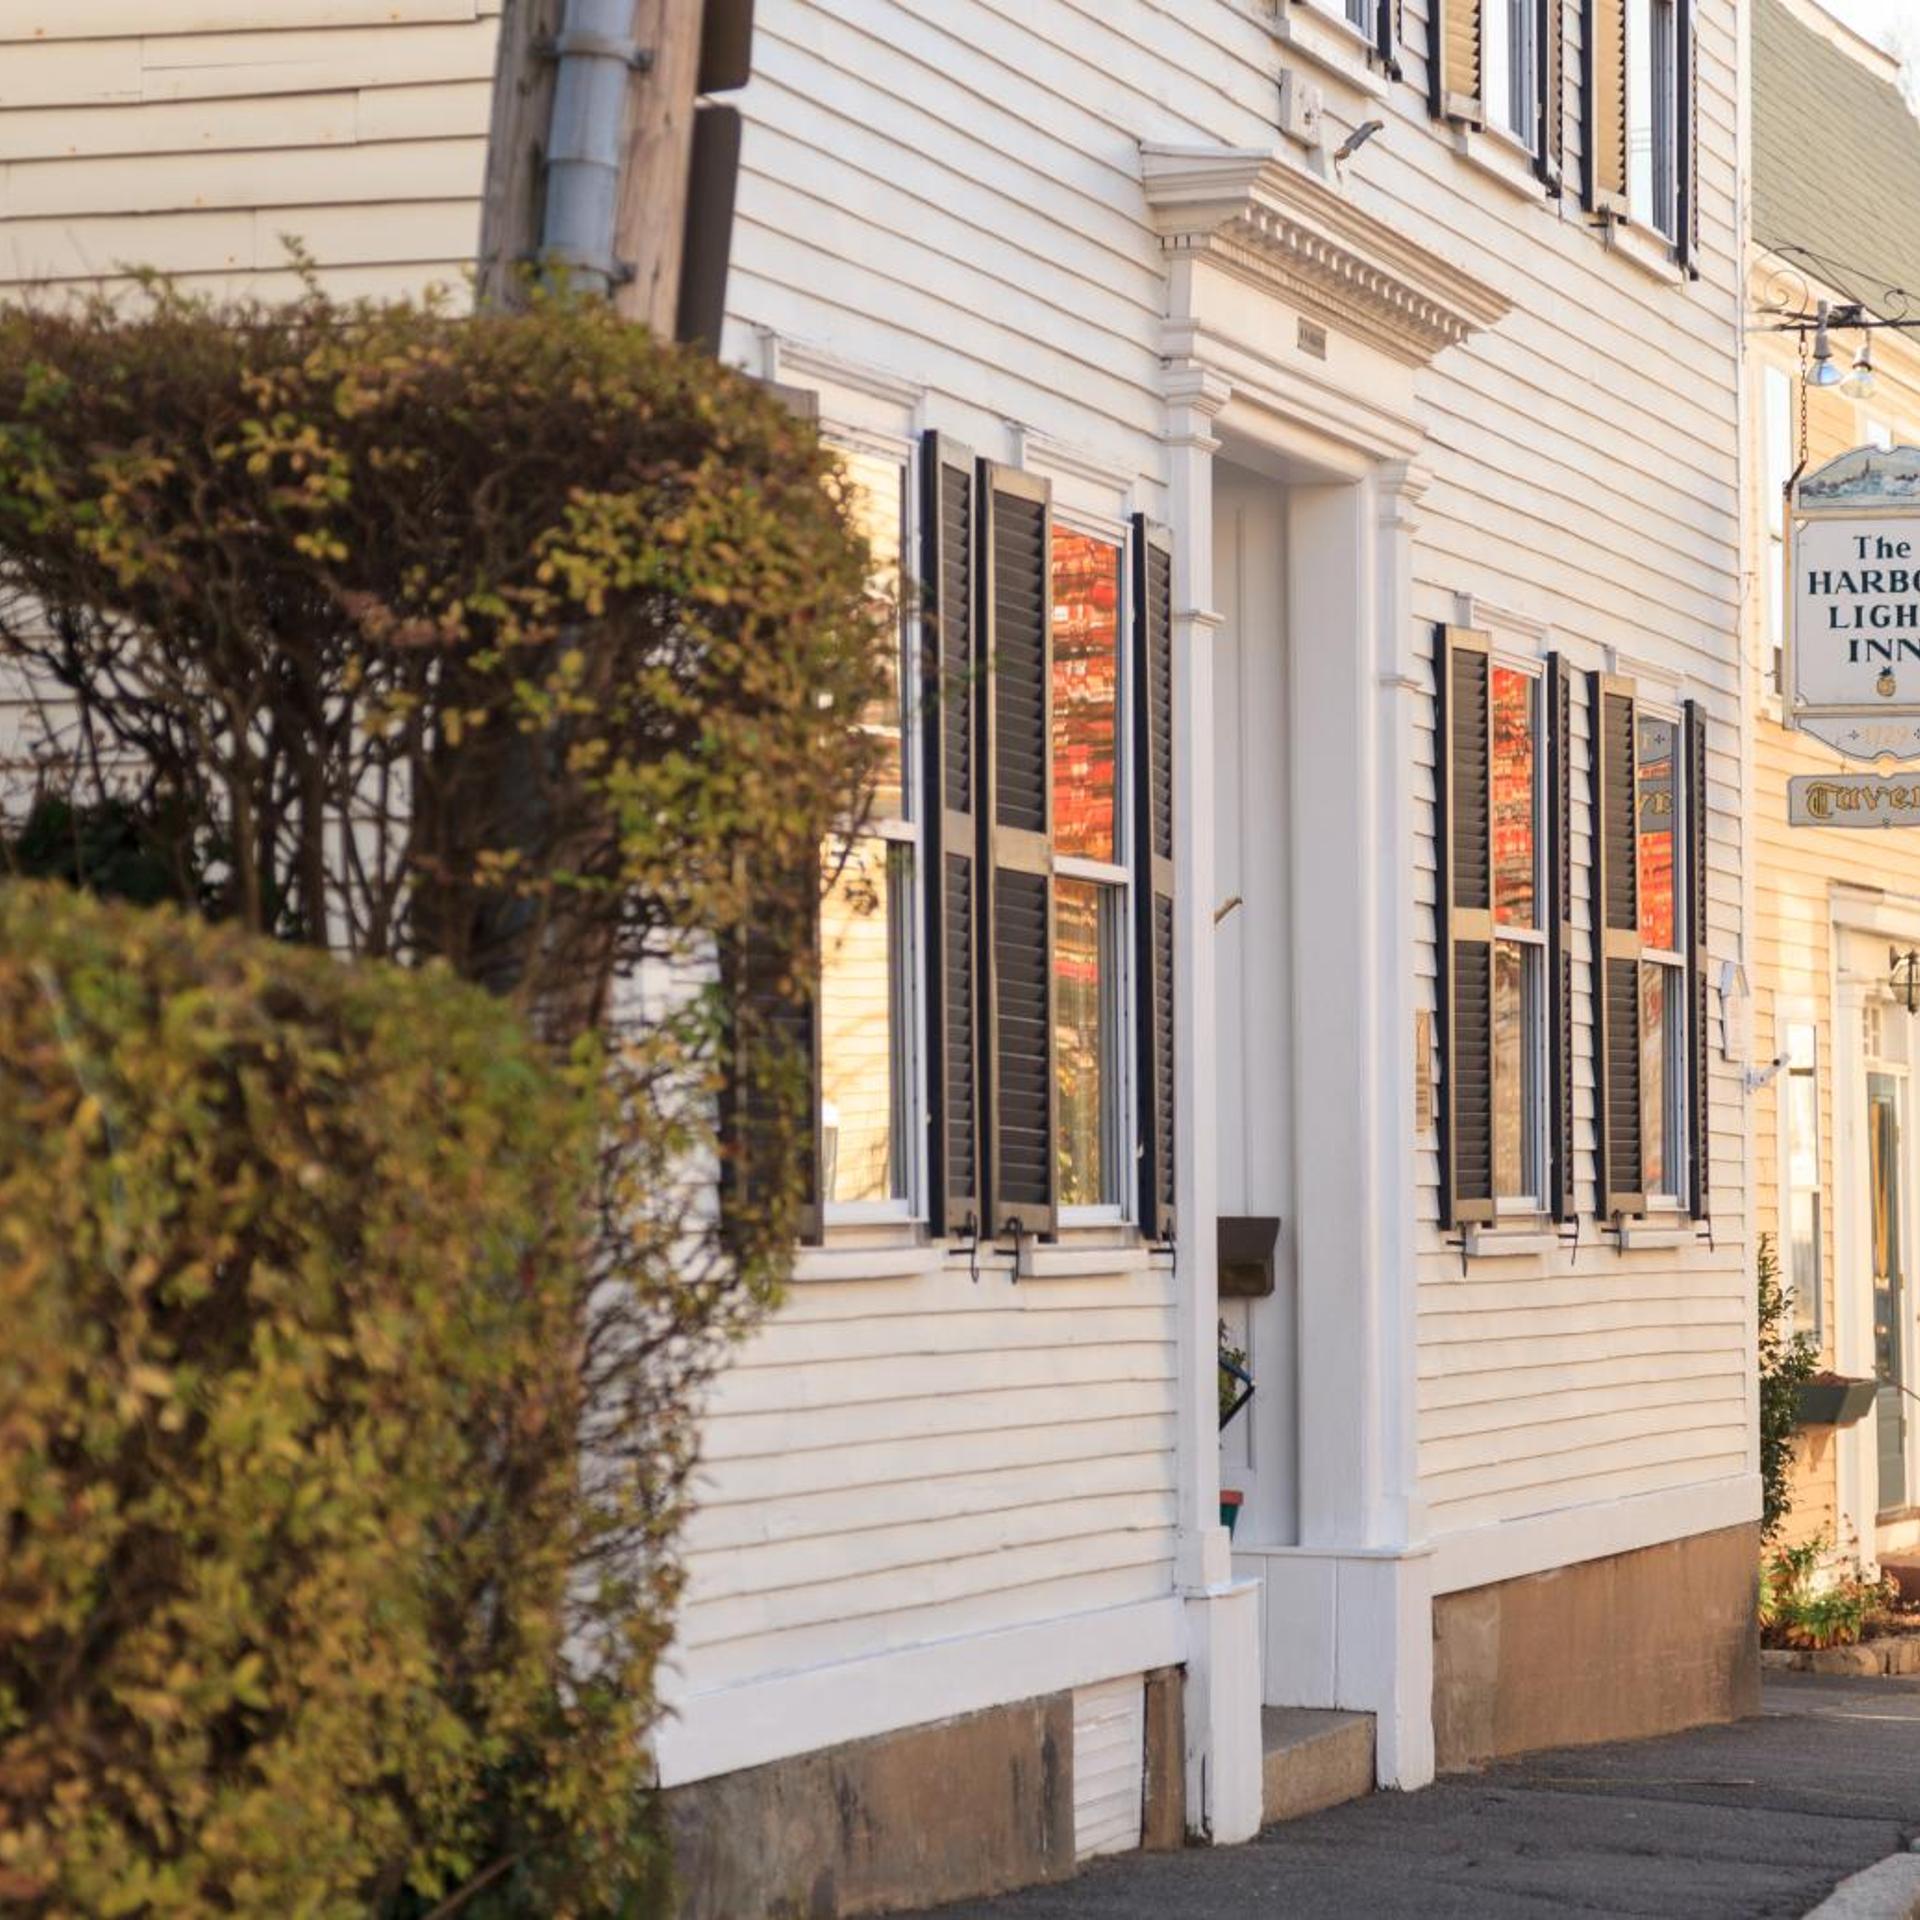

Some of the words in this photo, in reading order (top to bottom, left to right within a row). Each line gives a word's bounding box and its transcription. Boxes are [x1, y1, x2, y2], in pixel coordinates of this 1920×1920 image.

[1852, 535, 1912, 559] The
[1808, 569, 1920, 595] HARB
[1829, 604, 1919, 629] LIGH
[1849, 638, 1920, 662] INN
